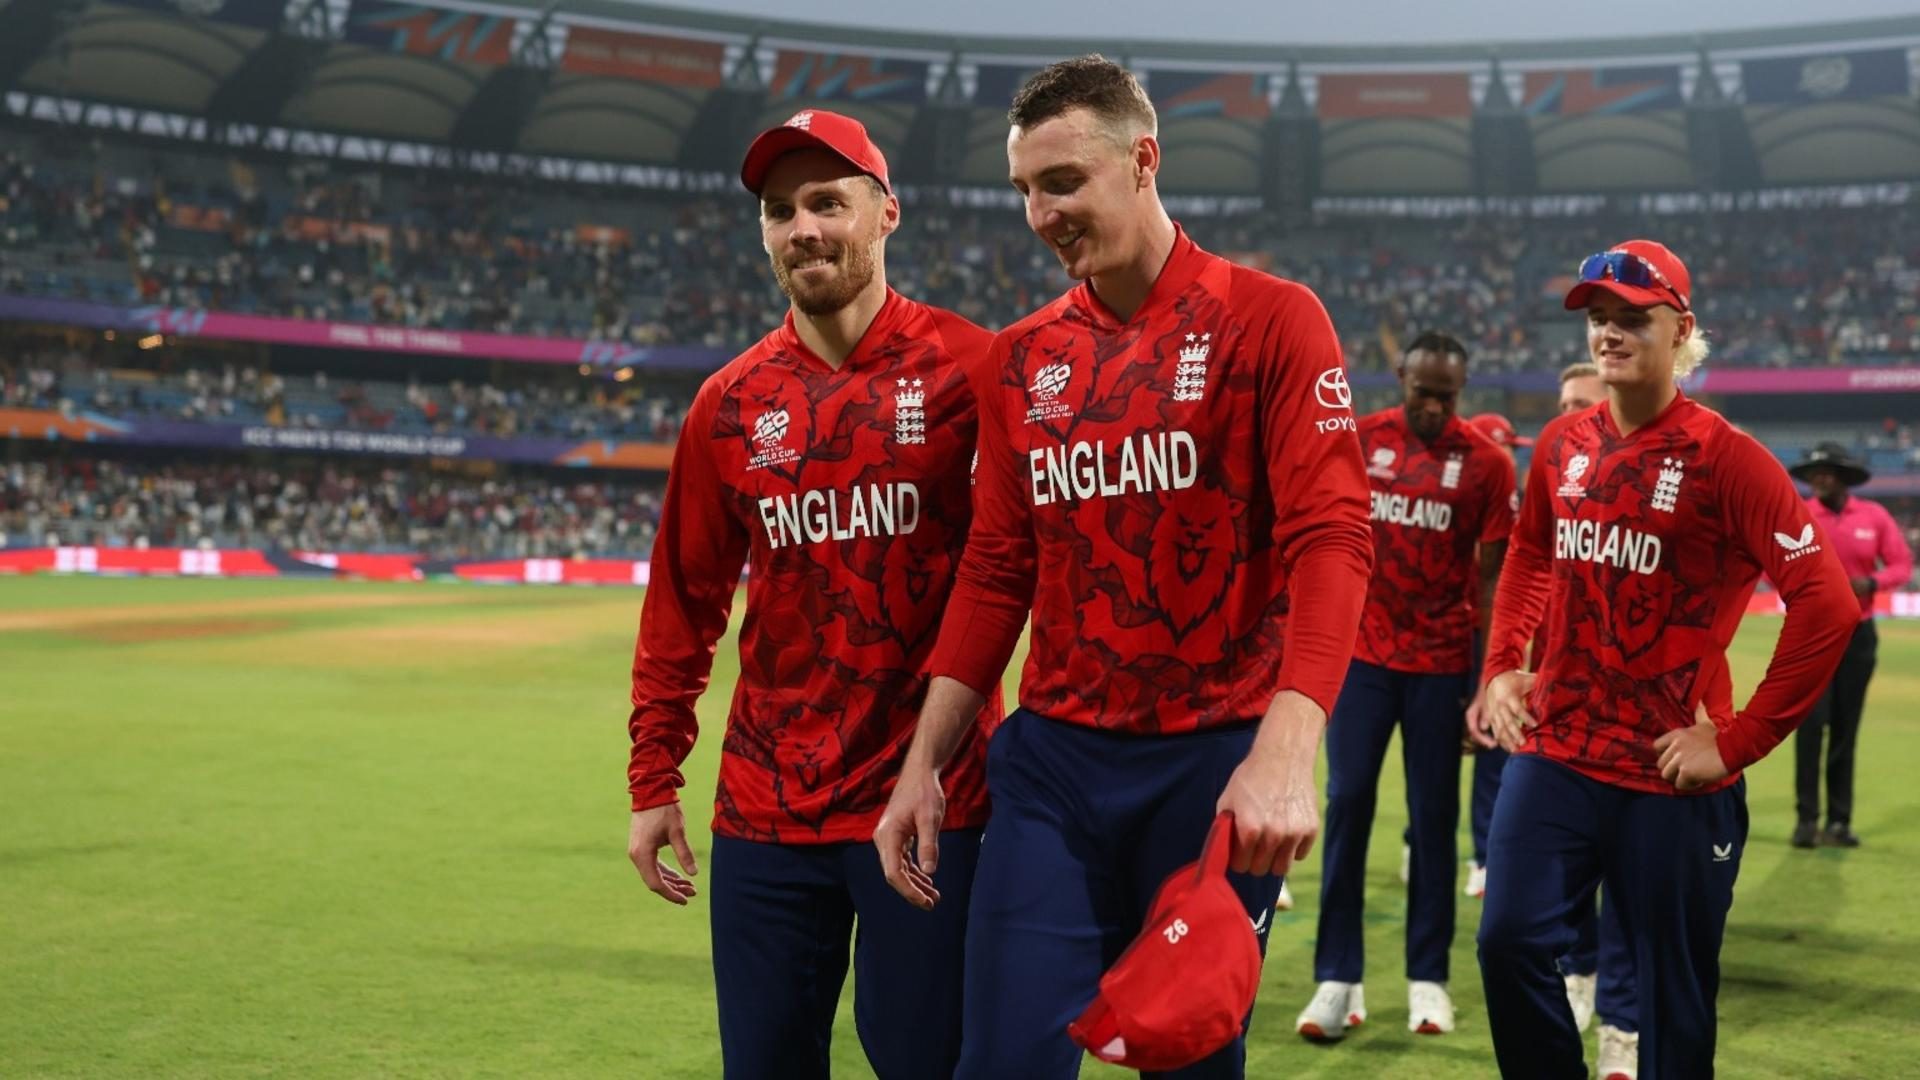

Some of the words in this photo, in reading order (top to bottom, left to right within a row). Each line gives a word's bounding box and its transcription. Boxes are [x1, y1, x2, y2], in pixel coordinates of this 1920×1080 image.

[1053, 404, 1070, 413] CUP
[242, 426, 273, 447] ICC
[366, 433, 428, 455] WORLD
[429, 436, 465, 456] CUP
[764, 439, 778, 448] ICC
[749, 452, 777, 464] WORLD
[778, 448, 796, 458] CUP
[1030, 430, 1198, 506] ENGLAND
[758, 482, 919, 549] ENGLAND
[1556, 518, 1661, 575] ENGLAND
[1162, 918, 1190, 945] 92
